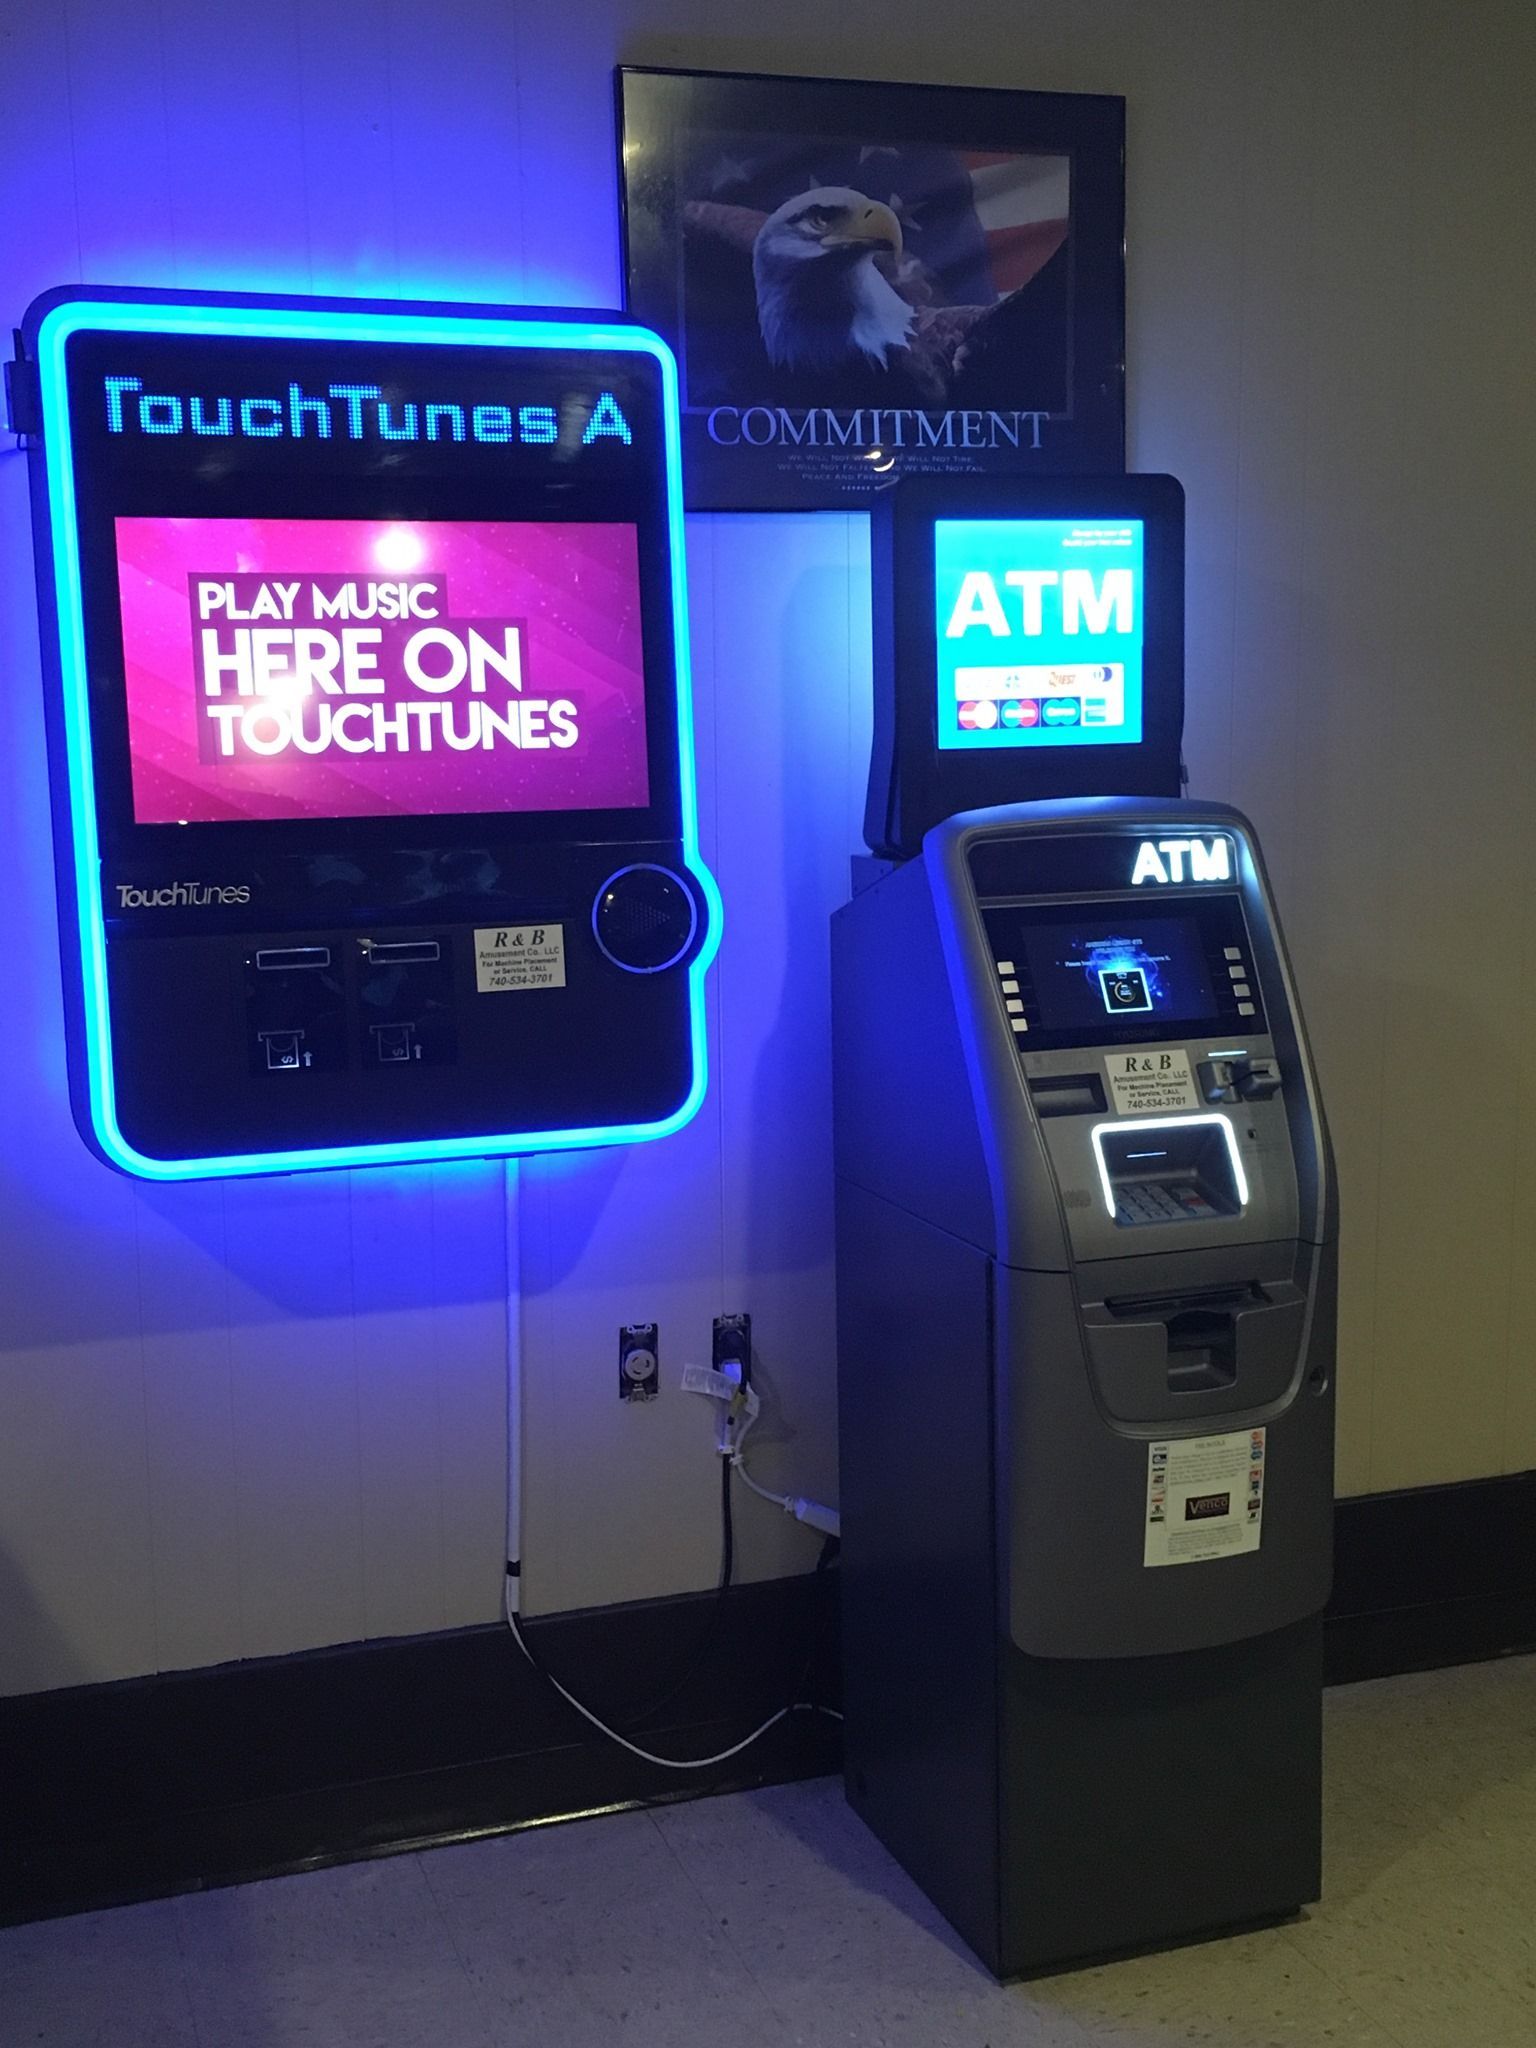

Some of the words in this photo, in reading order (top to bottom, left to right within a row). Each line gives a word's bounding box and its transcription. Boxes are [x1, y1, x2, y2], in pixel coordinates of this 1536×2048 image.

[105, 376, 557, 444] TouchTunes
[583, 392, 631, 445] A
[707, 405, 1050, 449] COMMITMENT
[199, 583, 300, 619] PLAY
[312, 583, 439, 619] MUSIC
[945, 569, 1133, 638] ATM
[202, 628, 385, 696] HERE
[403, 627, 522, 693] ON
[207, 699, 579, 756] TOUCHTUNES
[1131, 839, 1230, 885] ATM
[116, 881, 250, 908] TouchTunes
[480, 949, 525, 959] Amusement
[545, 947, 560, 955] LLC
[494, 931, 508, 948] R
[512, 933, 524, 947] &
[531, 929, 545, 945] B
[489, 974, 553, 986] 740-534-3701
[1114, 1073, 1155, 1083] Amusement
[1173, 1070, 1188, 1079] LLC
[1125, 1057, 1138, 1072] R
[1141, 1058, 1153, 1071] &
[1160, 1054, 1172, 1070] B
[1127, 1096, 1186, 1109] 740-534-3701
